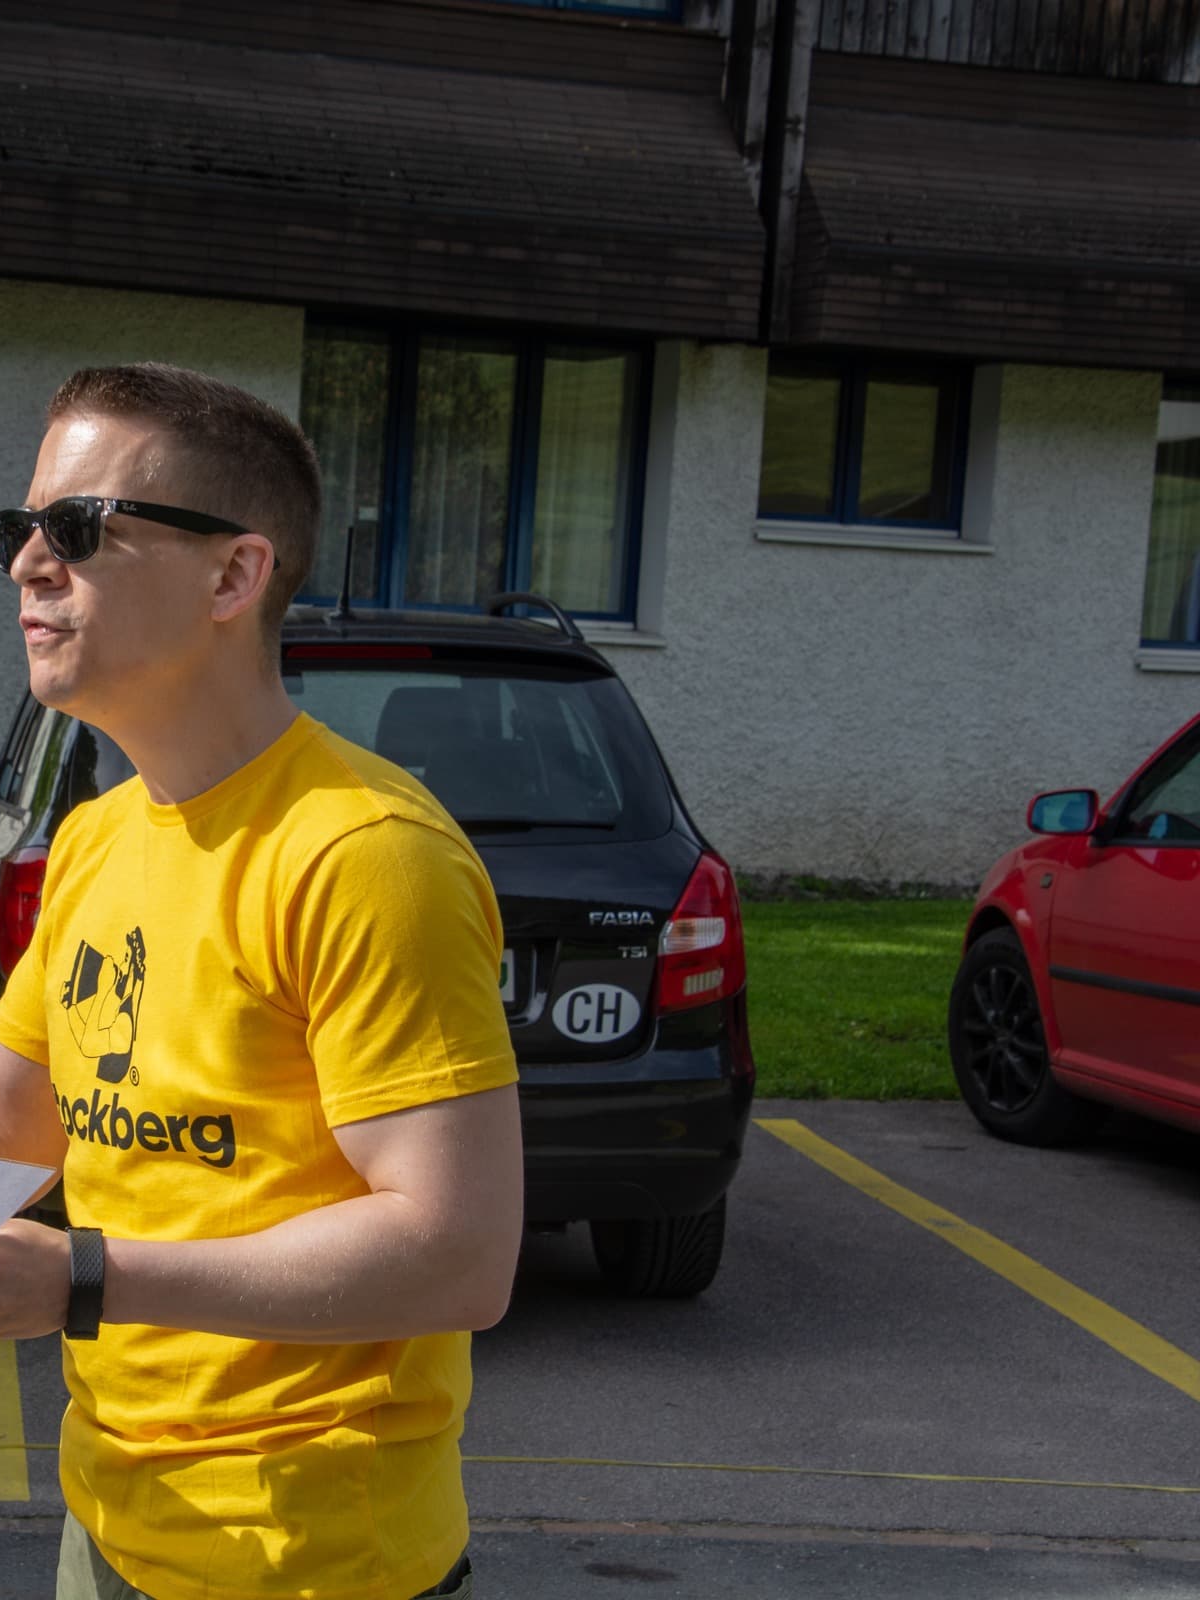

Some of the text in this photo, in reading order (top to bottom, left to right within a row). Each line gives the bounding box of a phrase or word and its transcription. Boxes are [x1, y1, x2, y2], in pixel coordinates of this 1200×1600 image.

[588, 911, 655, 926] FABIA
[565, 990, 623, 1034] CH
[53, 1083, 236, 1169] ockberg
